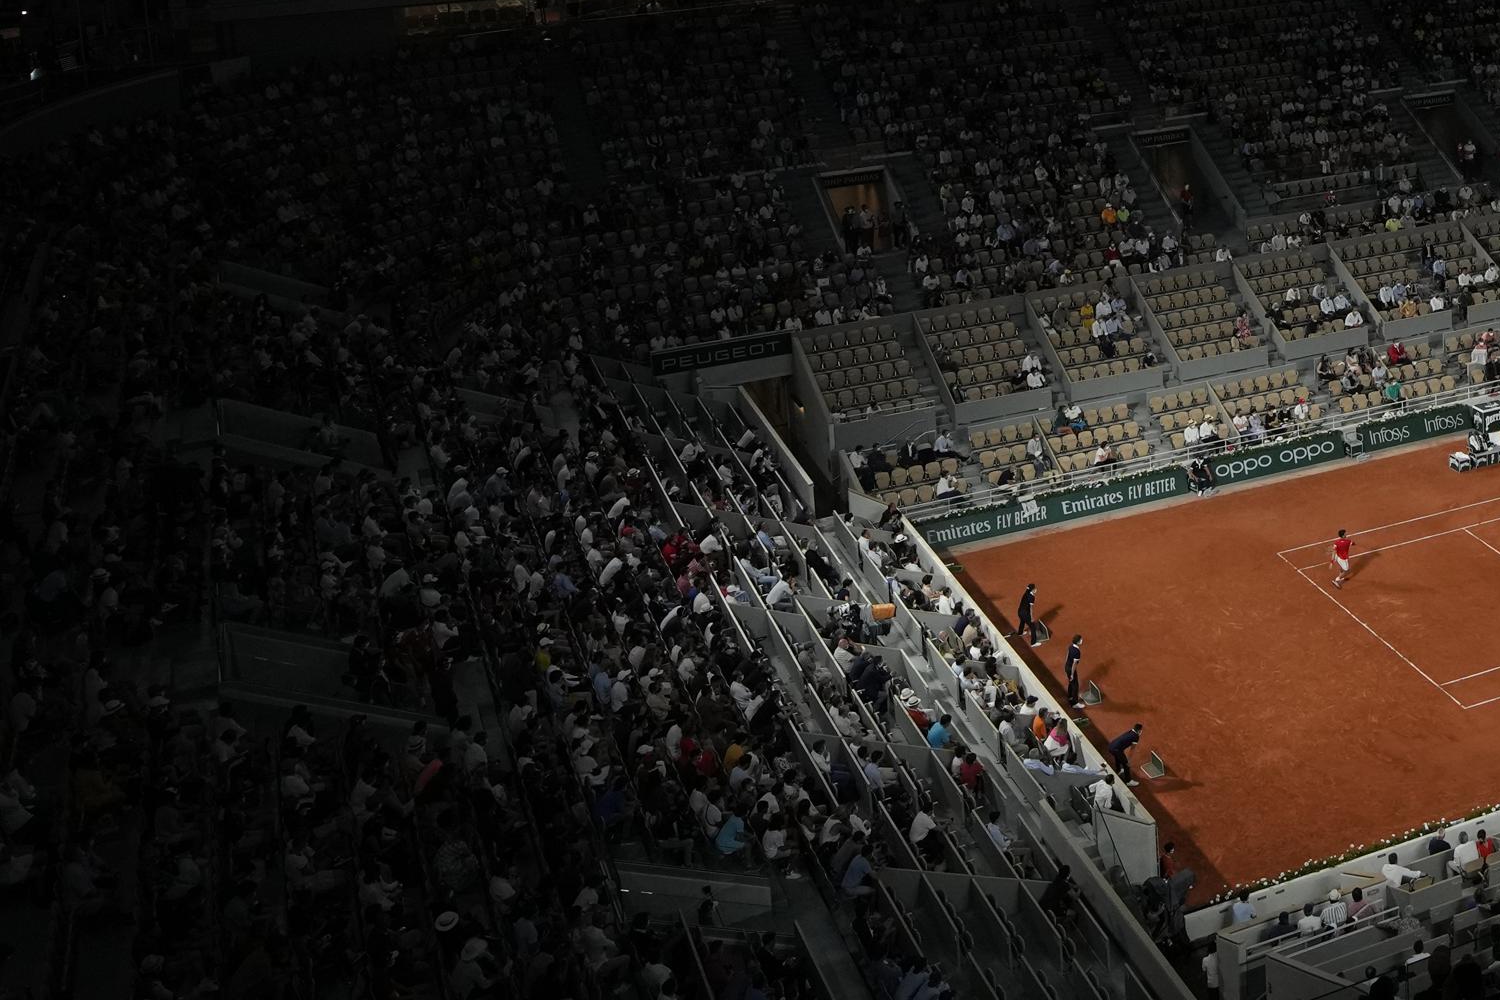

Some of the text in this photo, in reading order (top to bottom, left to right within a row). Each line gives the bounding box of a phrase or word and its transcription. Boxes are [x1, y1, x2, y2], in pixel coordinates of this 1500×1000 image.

[661, 340, 780, 371] PEUGEOT
[1424, 413, 1464, 433] Infosys
[1369, 425, 1410, 445] Infosys
[1279, 441, 1335, 464] oppo
[1215, 455, 1272, 478] oppo
[1061, 477, 1176, 515] Emirates FLY BETTER
[926, 519, 991, 545] Emirates
[996, 513, 1012, 531] FLY
